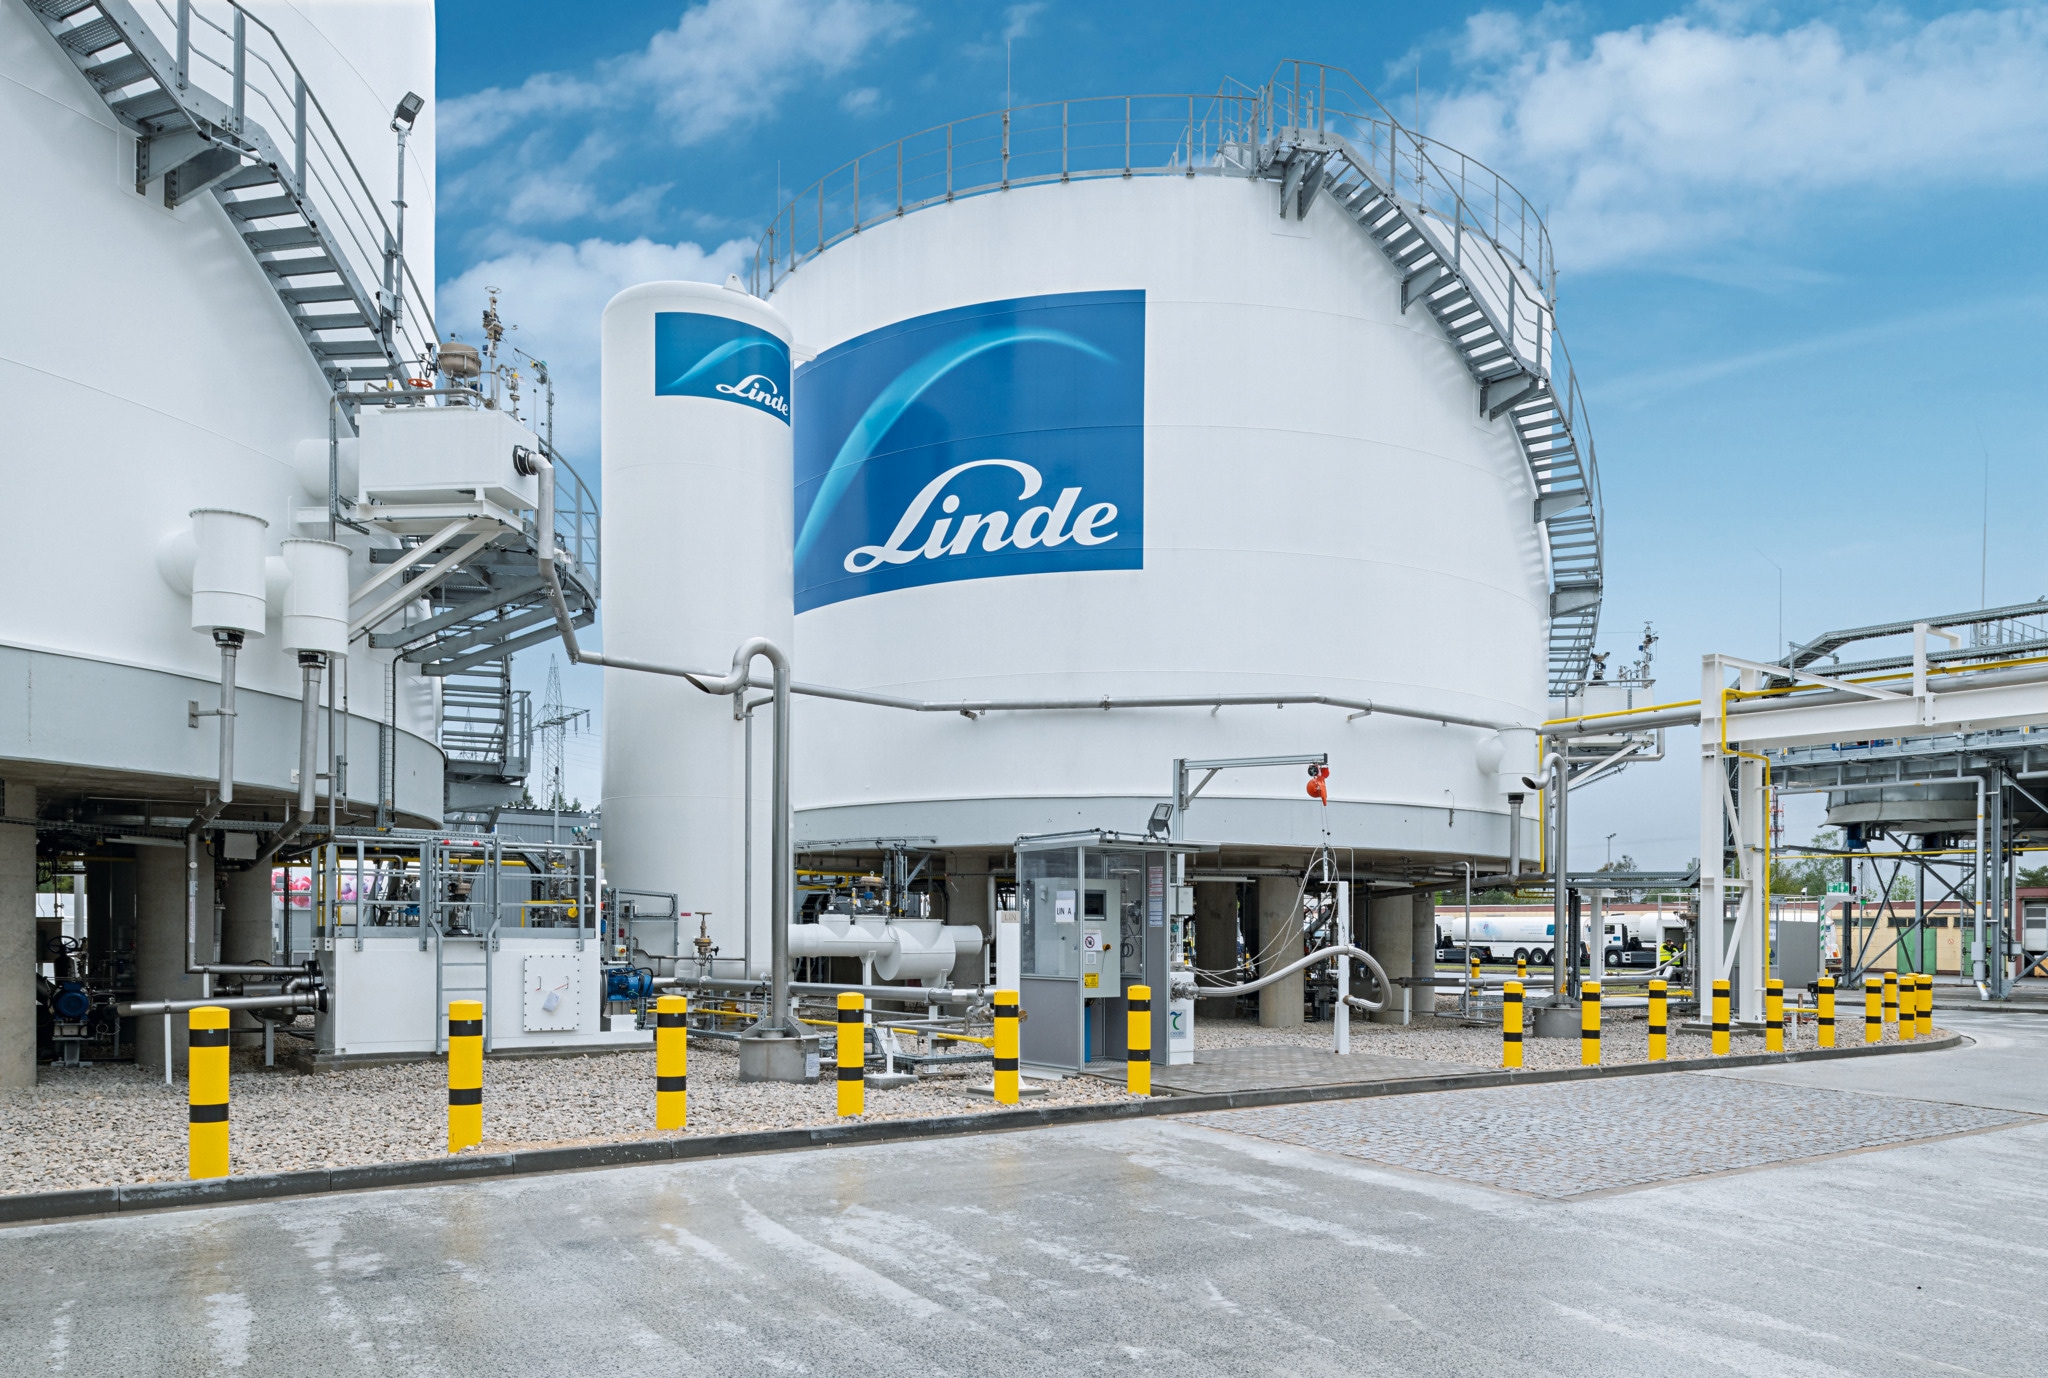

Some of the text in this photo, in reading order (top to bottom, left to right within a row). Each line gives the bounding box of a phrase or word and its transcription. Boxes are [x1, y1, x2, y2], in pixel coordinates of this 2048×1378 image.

[716, 374, 789, 416] Linde
[843, 458, 1119, 573] Linde
[1004, 913, 1017, 921] LIN
[1056, 907, 1065, 915] LIN
